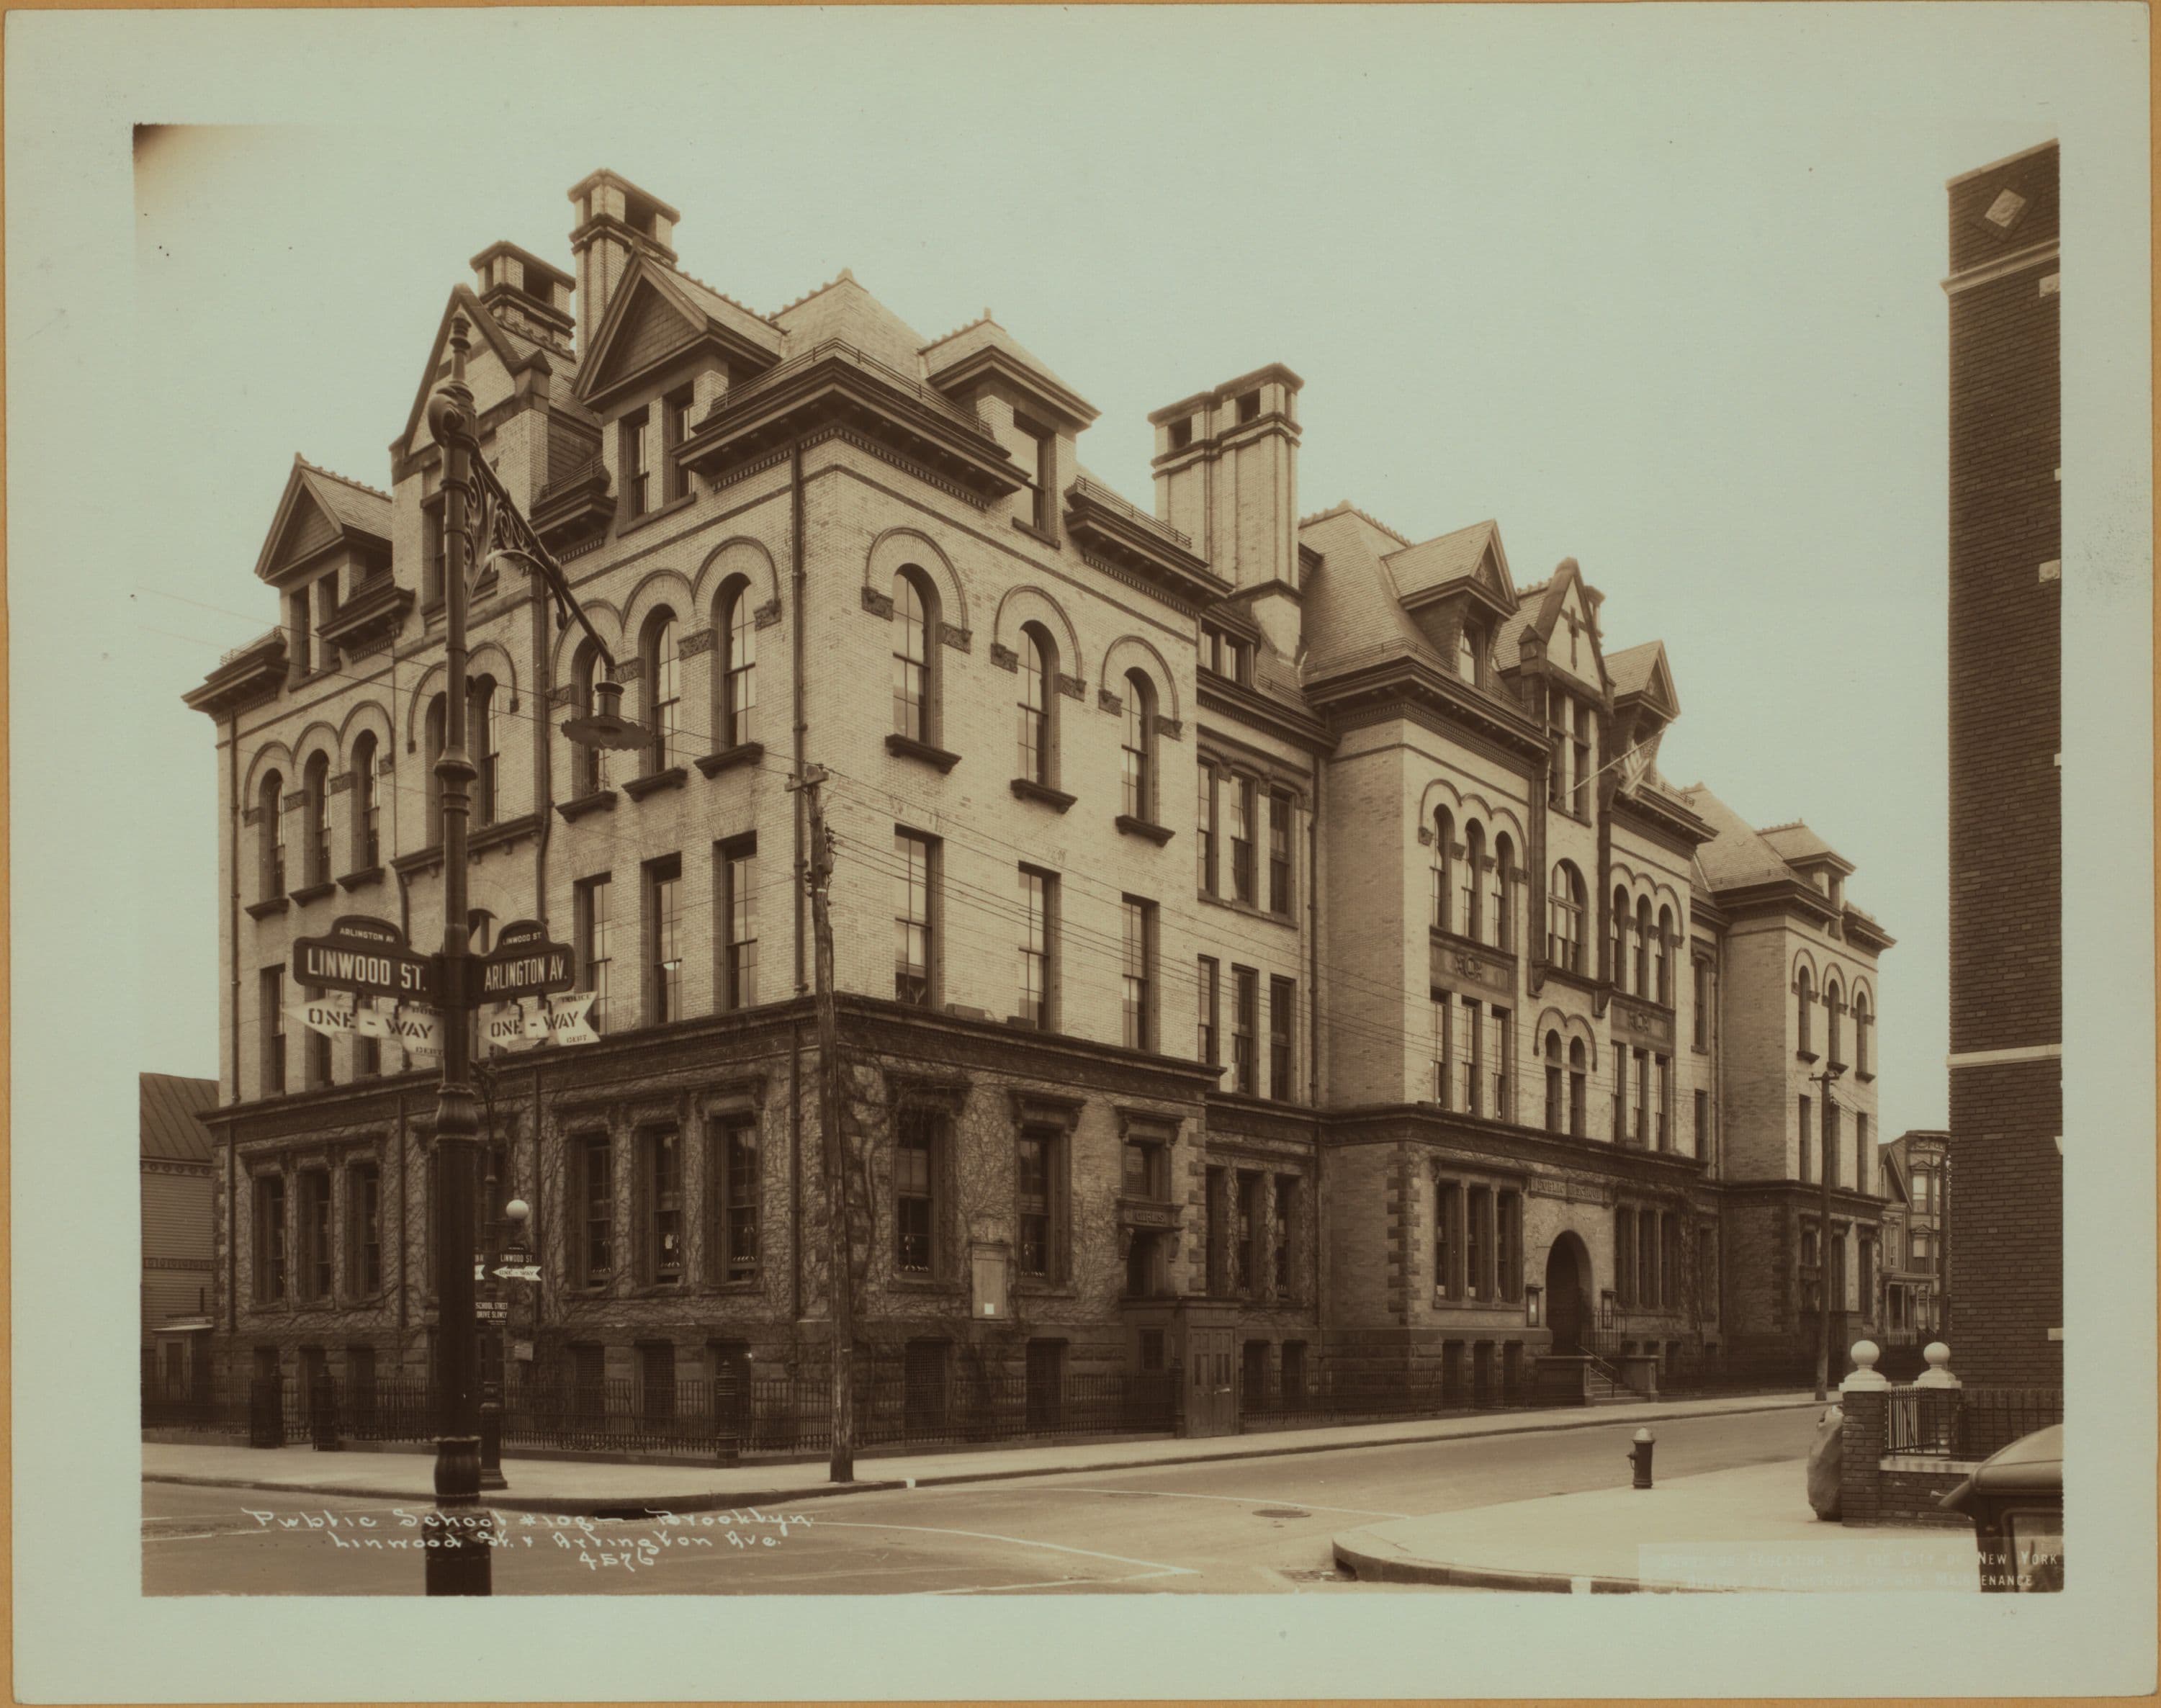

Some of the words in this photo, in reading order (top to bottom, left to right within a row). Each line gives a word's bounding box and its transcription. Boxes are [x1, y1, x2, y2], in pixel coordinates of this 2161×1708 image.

[339, 927, 383, 941] ARLINGTON
[503, 934, 531, 945] LINWOOD
[307, 948, 390, 986] LINWOOD
[400, 965, 427, 991] ST.
[485, 957, 544, 992] ARLINGTON
[549, 955, 567, 981] AV.
[308, 1008, 356, 1029] ONE
[386, 1020, 433, 1040] WAY
[491, 1018, 524, 1037] ONE
[544, 1011, 579, 1030] WAY
[500, 1254, 524, 1262] LINWOOD
